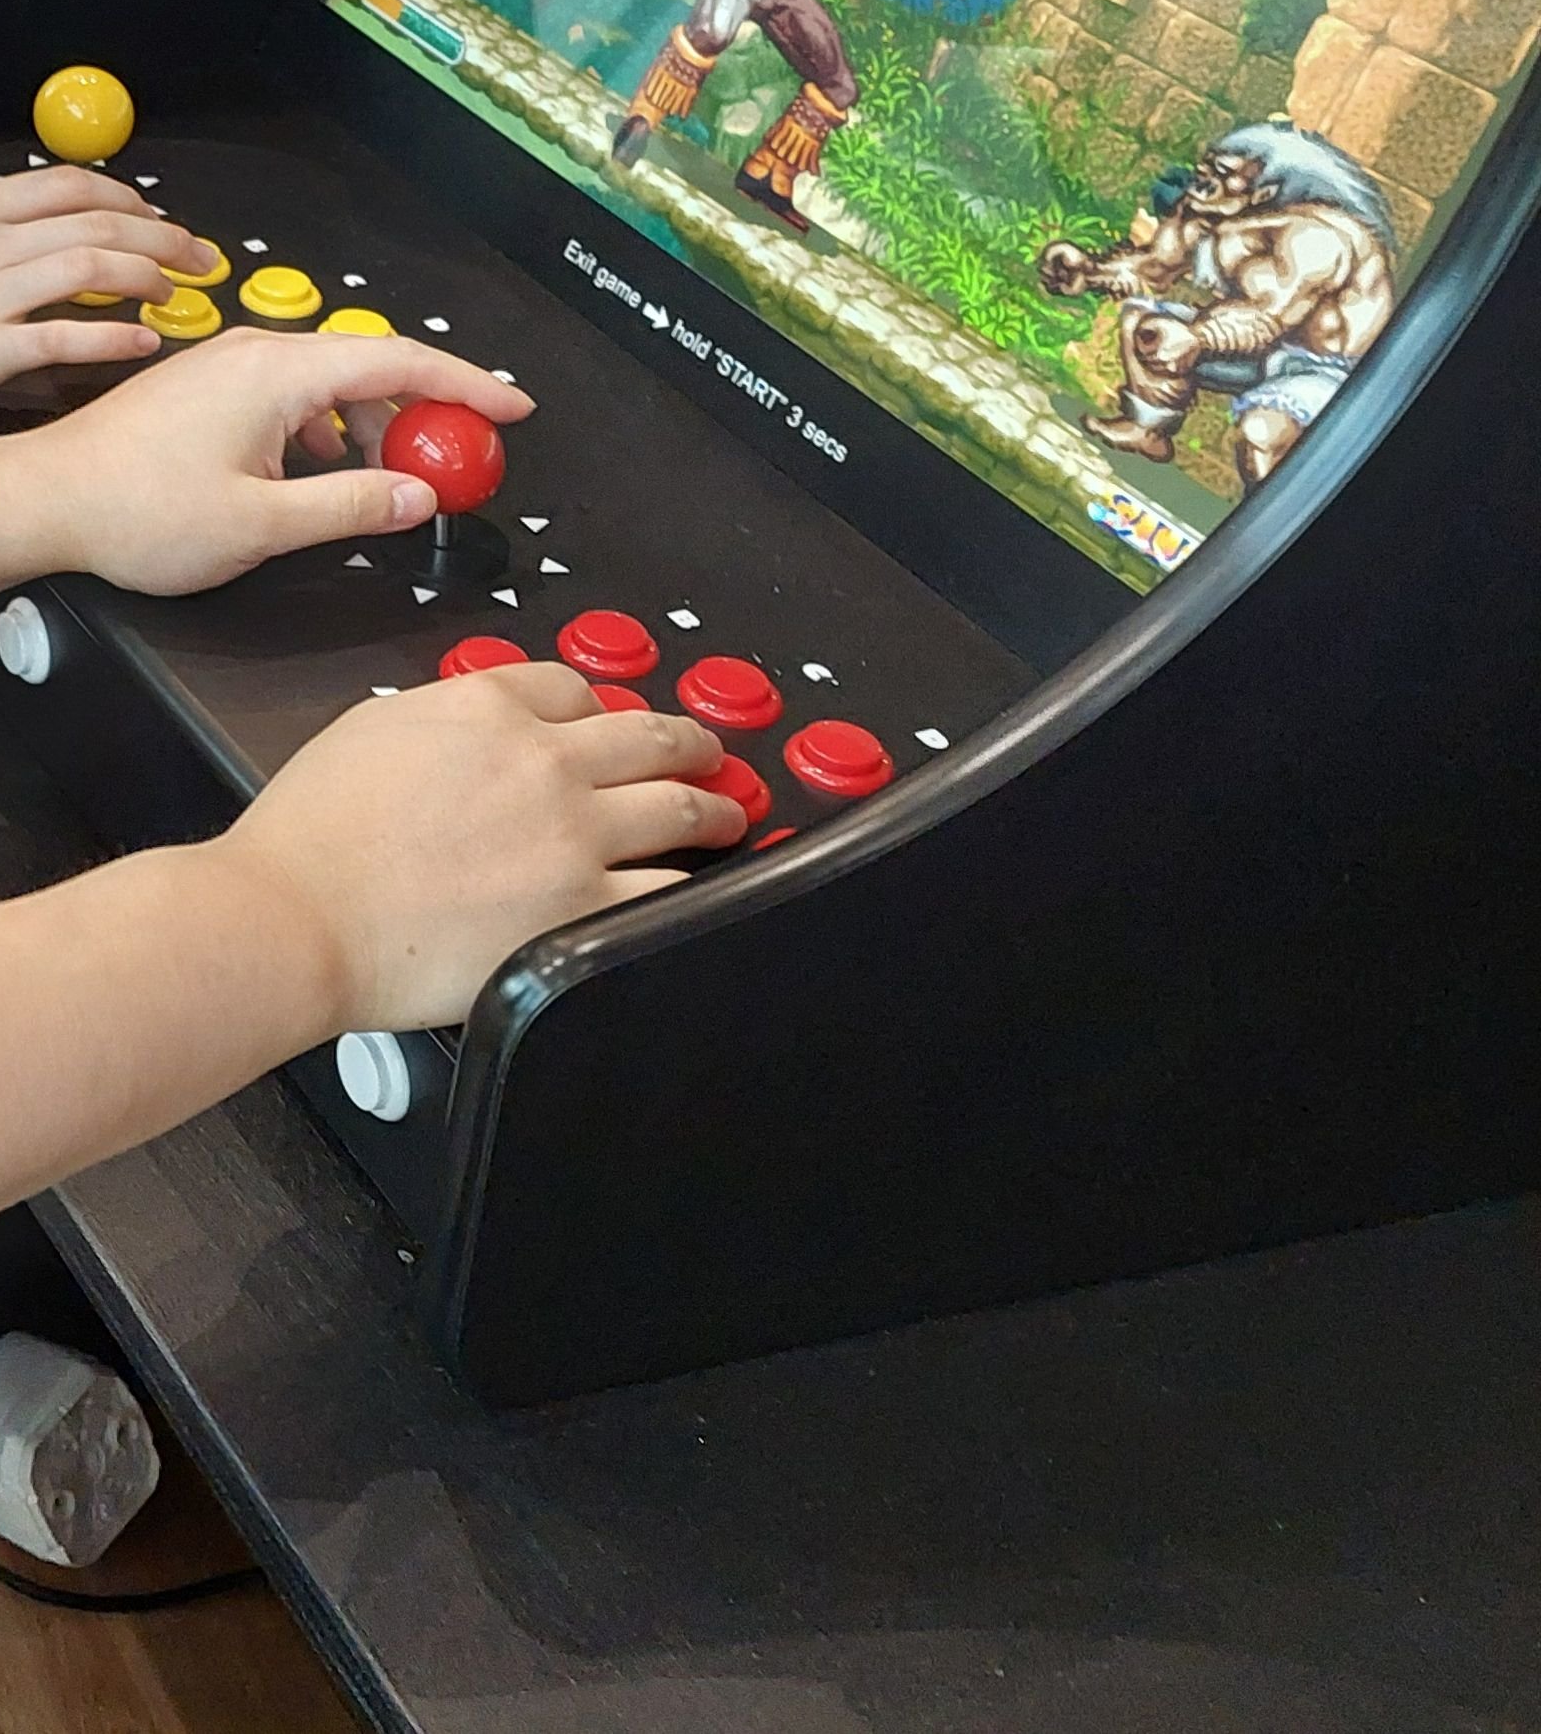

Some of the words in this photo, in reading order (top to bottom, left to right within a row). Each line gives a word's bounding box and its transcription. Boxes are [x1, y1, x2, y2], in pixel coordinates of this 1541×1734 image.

[563, 238, 598, 276] Exit
[593, 266, 642, 308] game
[670, 318, 713, 361] hold
[785, 405, 804, 428] 3
[801, 421, 849, 463] secs
